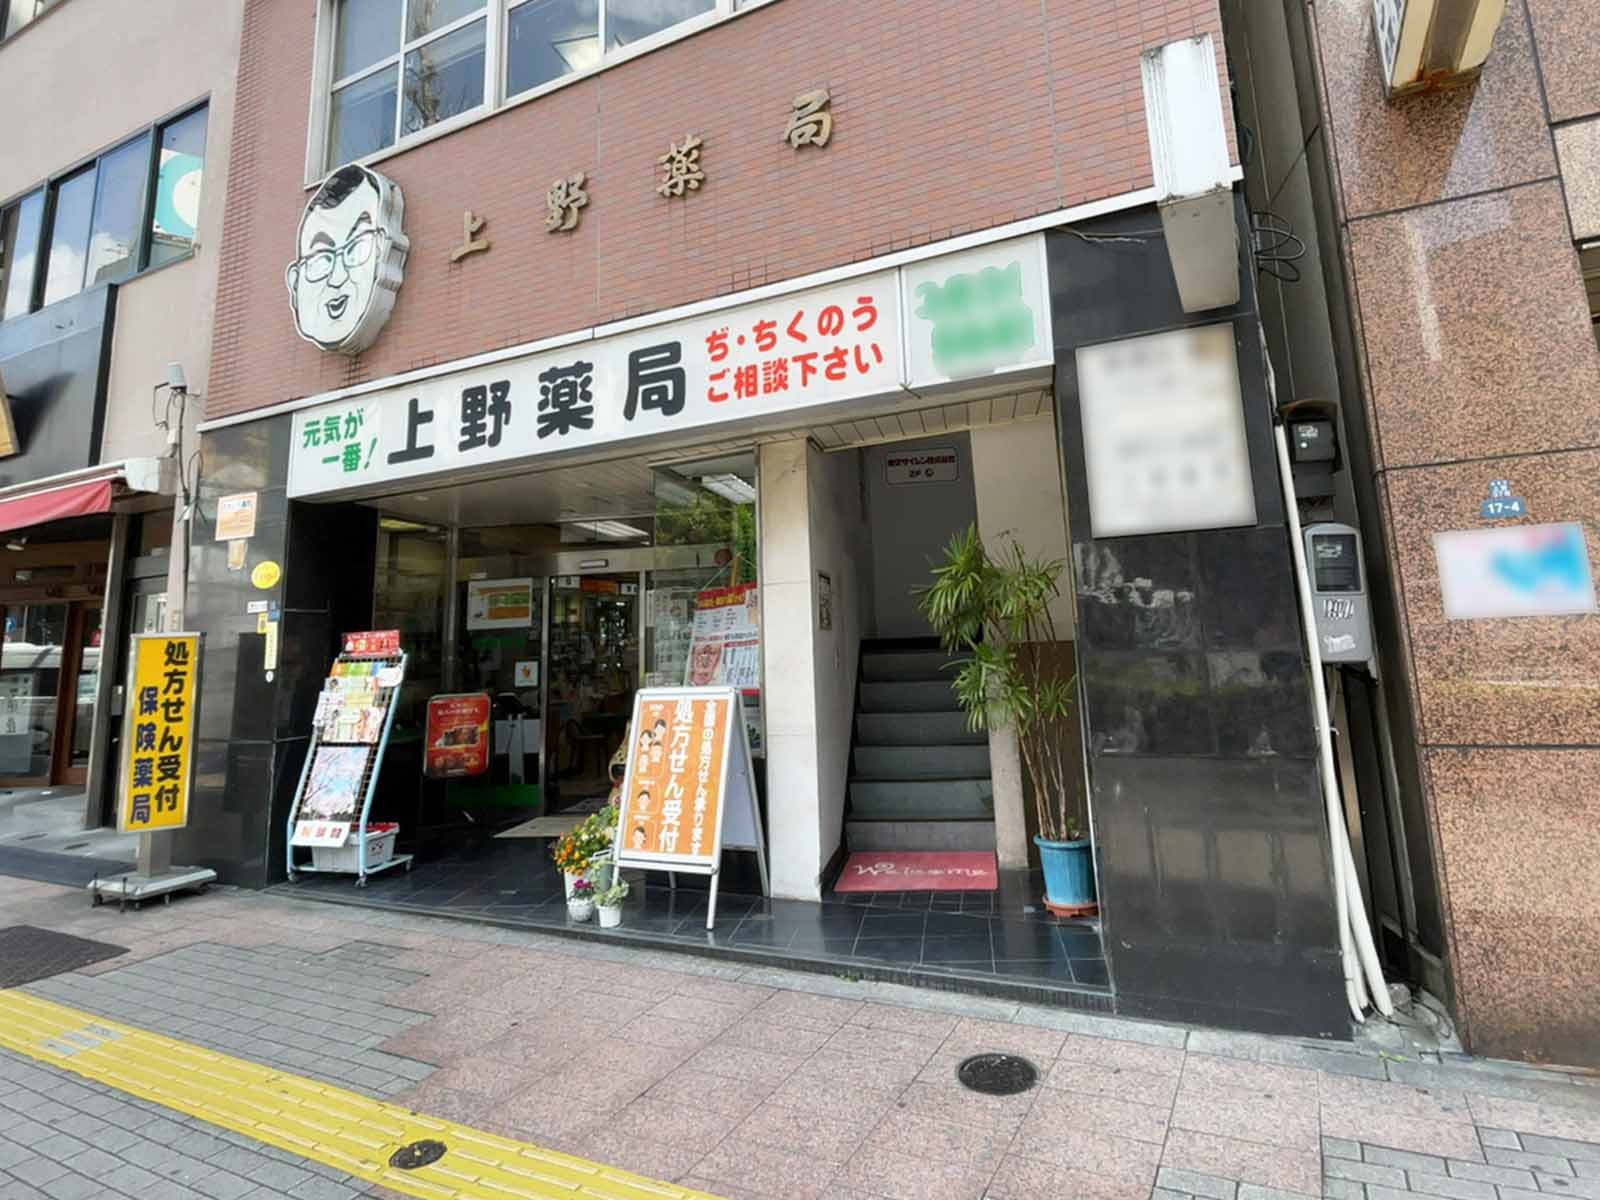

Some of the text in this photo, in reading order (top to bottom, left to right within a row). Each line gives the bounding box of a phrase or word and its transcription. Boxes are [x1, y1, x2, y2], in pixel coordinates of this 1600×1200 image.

[448, 87, 833, 263] 上野薬局
[704, 296, 879, 362] ぢ・ちくのう
[706, 342, 884, 403] ご相談下さい
[302, 406, 366, 449] 元気が
[386, 340, 687, 466] 上野薬局
[1487, 501, 1521, 514] 17-4
[130, 685, 159, 825] 保険薬局
[154, 640, 190, 812] 処方せん受付
[658, 700, 695, 853] 処方せん受付
